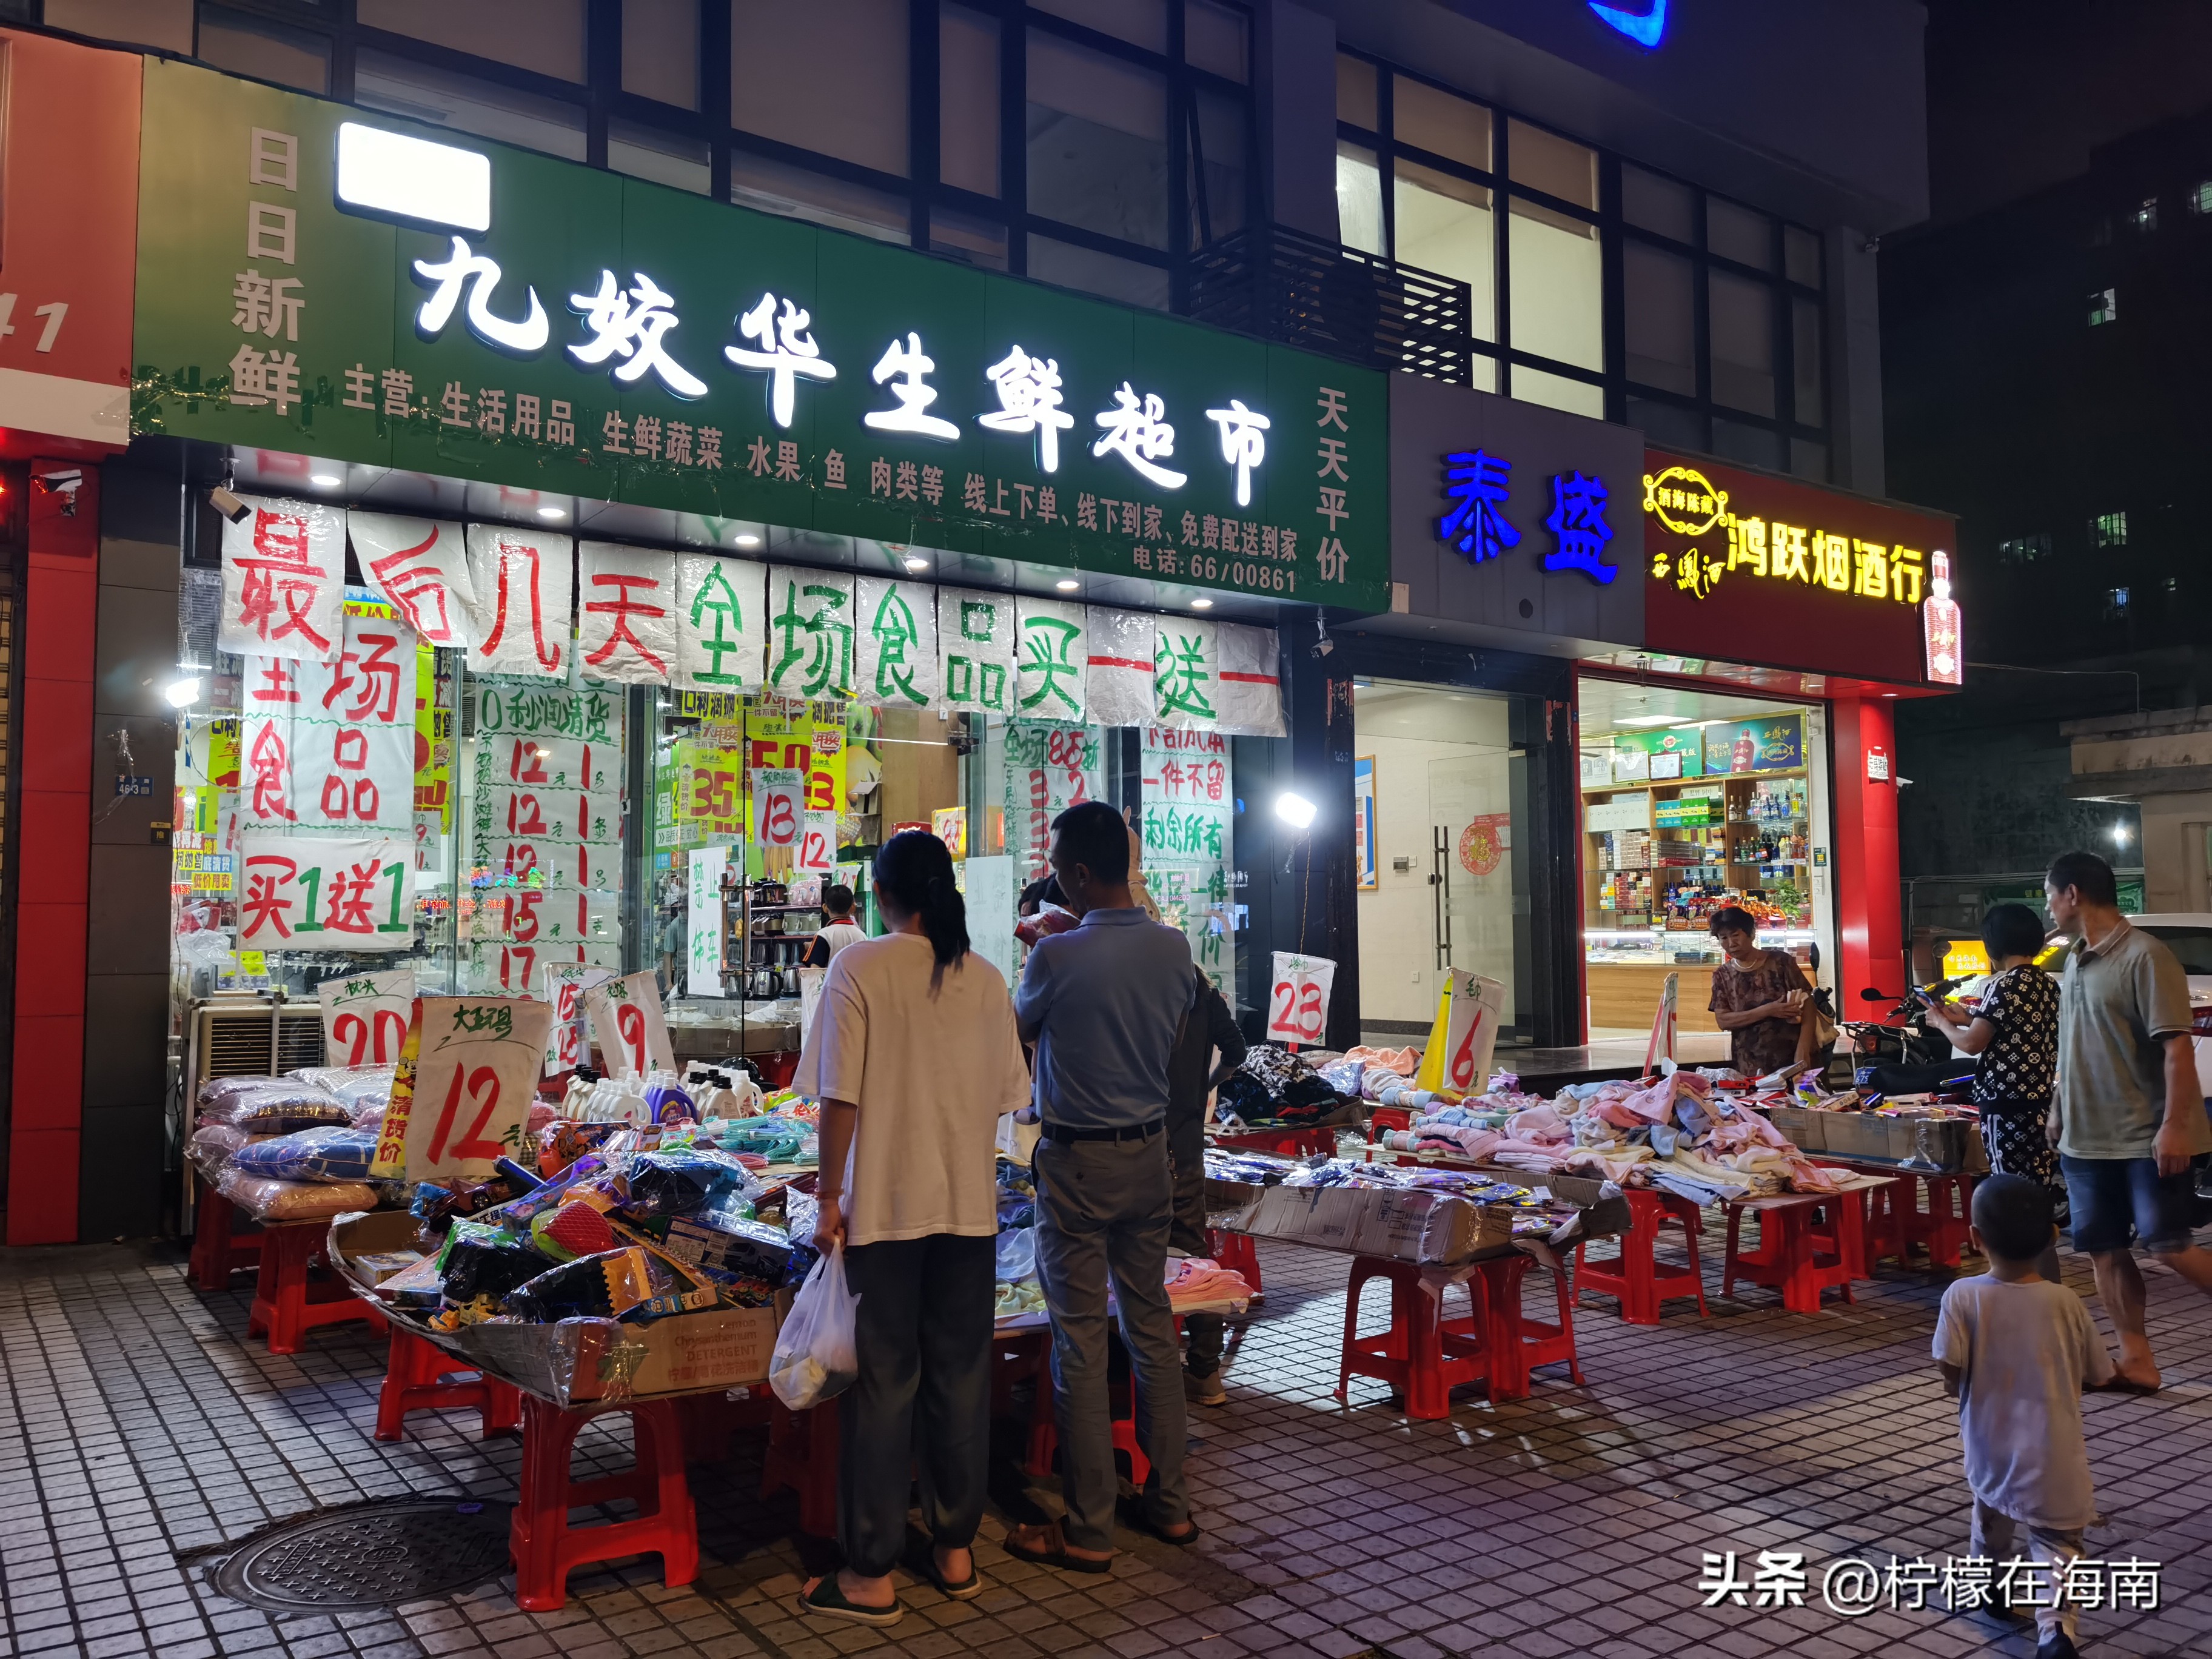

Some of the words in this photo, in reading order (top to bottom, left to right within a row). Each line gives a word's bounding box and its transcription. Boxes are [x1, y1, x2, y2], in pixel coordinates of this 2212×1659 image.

[229, 126, 305, 416] 日日新鲜
[603, 411, 723, 469] 生鲜蔬菜
[747, 436, 800, 481] 水果
[824, 448, 847, 489] 鱼
[871, 457, 943, 505] 肉类等
[1316, 386, 1349, 583] 天天平价
[1437, 448, 1618, 585] 泰盛
[1727, 512, 1925, 604] 鸿跃烟酒行
[249, 719, 380, 822] 食品
[691, 768, 735, 818] 35
[1142, 758, 1225, 800] 一件不留
[1144, 806, 1224, 860] 剩余所有
[380, 1095, 414, 1164] 清货价
[686, 1344, 757, 1362] DETERGENT
